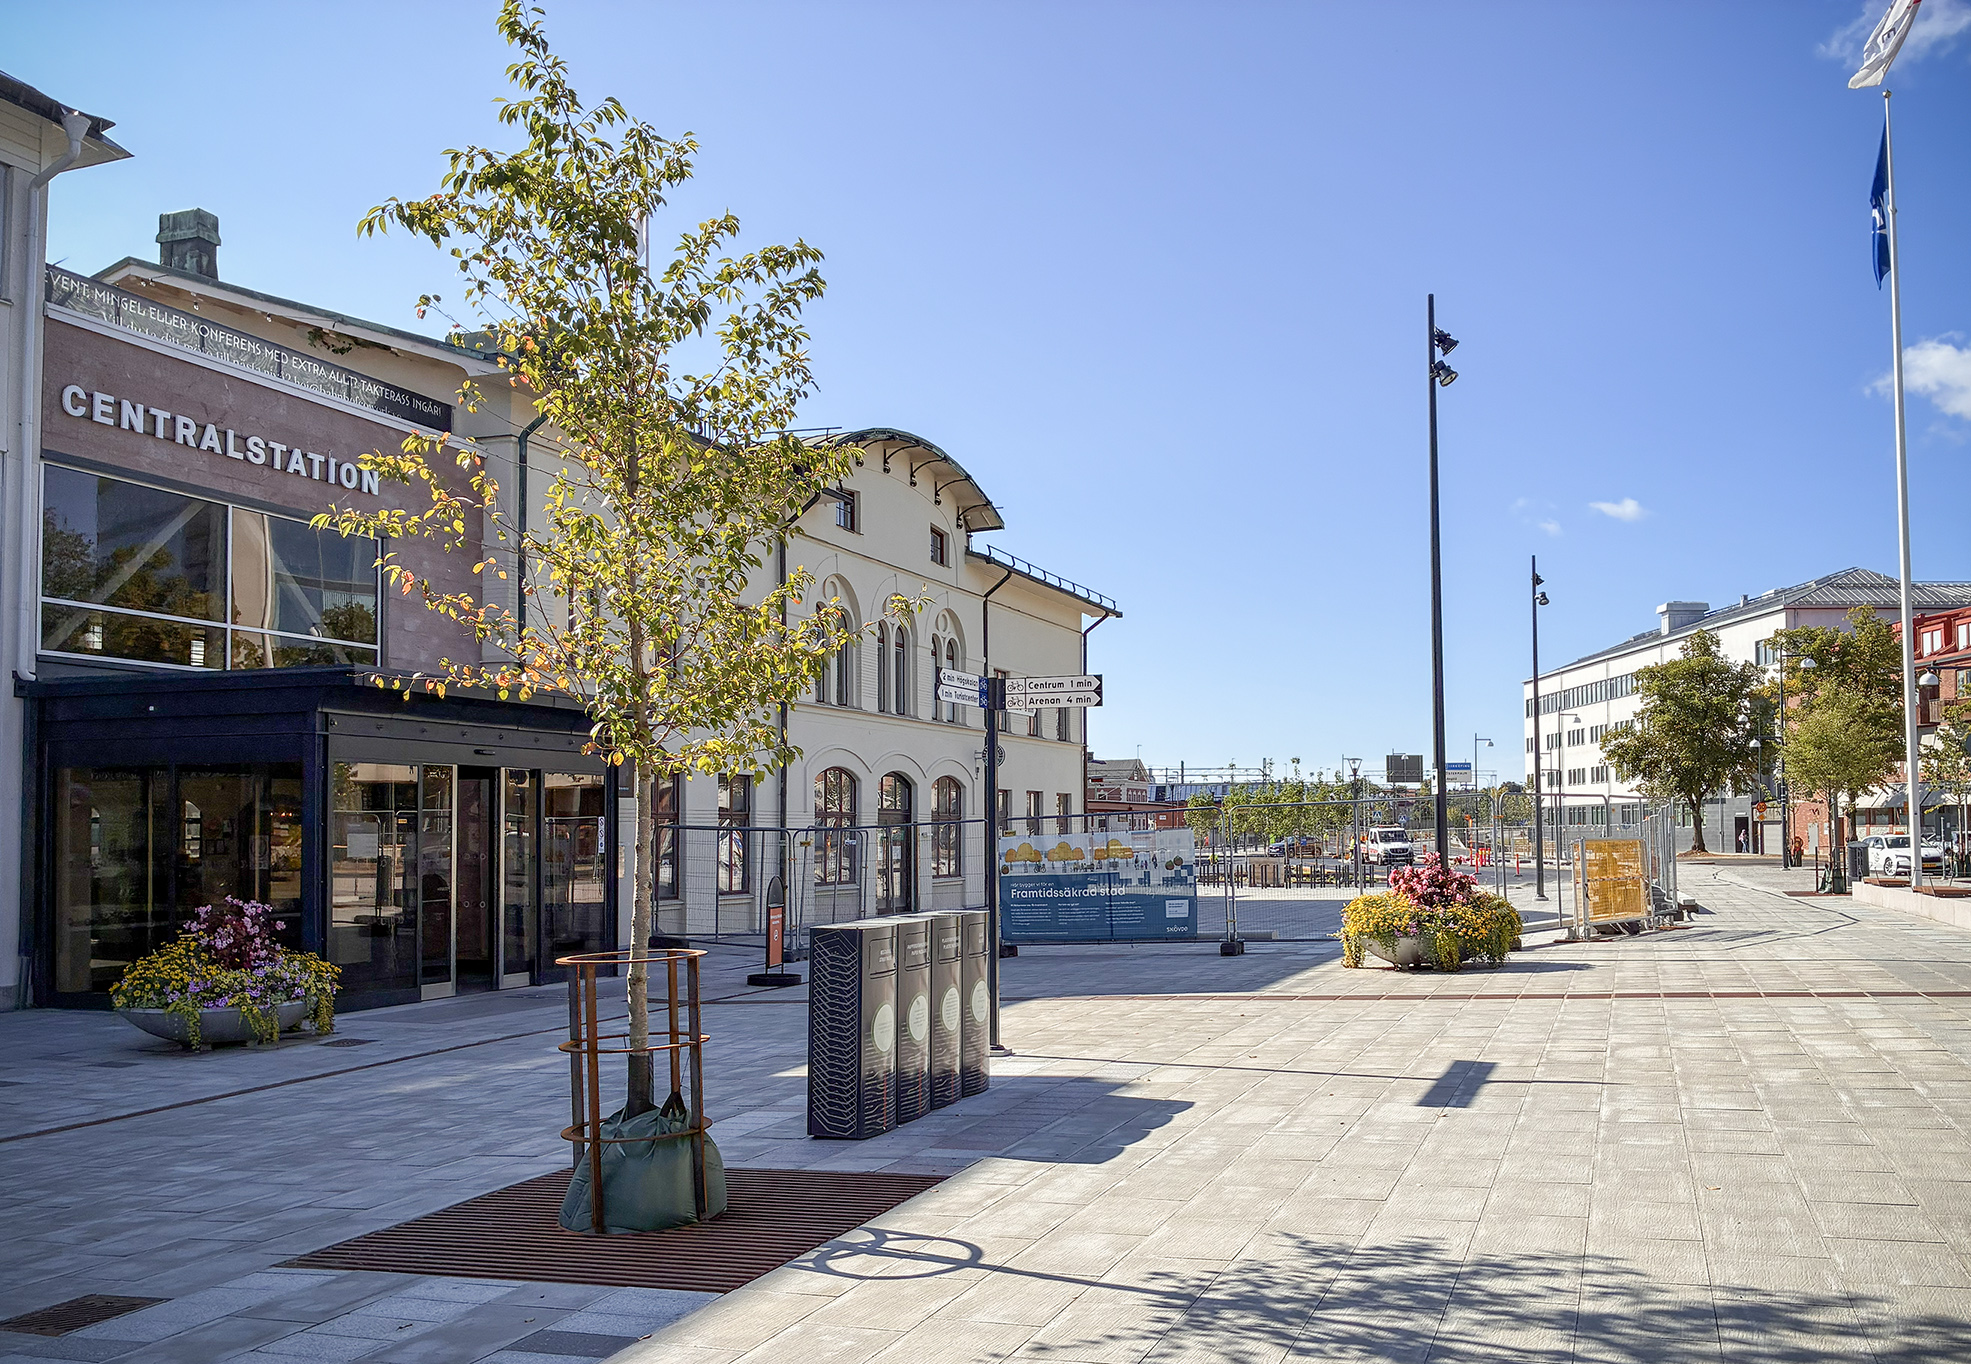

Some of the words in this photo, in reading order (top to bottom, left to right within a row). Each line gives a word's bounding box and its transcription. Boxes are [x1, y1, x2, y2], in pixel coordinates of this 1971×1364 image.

[95, 288, 146, 316] MINGEL
[149, 306, 187, 331] ELLER
[191, 321, 262, 356] KONFERENS
[264, 346, 289, 364] MED
[292, 356, 327, 379] EXTRA
[328, 369, 358, 387] ALLT?
[360, 379, 410, 407] TAKTERASS
[412, 397, 442, 417] INGÅR!
[62, 384, 380, 496] CENTRALSTATION
[942, 672, 947, 681] 2
[947, 674, 955, 682] min
[1028, 681, 1065, 690] Centrum
[1070, 680, 1074, 688] 1
[1076, 680, 1092, 688] min
[1028, 697, 1061, 705] Arenan
[1066, 696, 1073, 704] 4
[1075, 695, 1092, 703] min
[1011, 887, 1097, 899] Framtidssäkrad
[1100, 885, 1126, 896] stad
